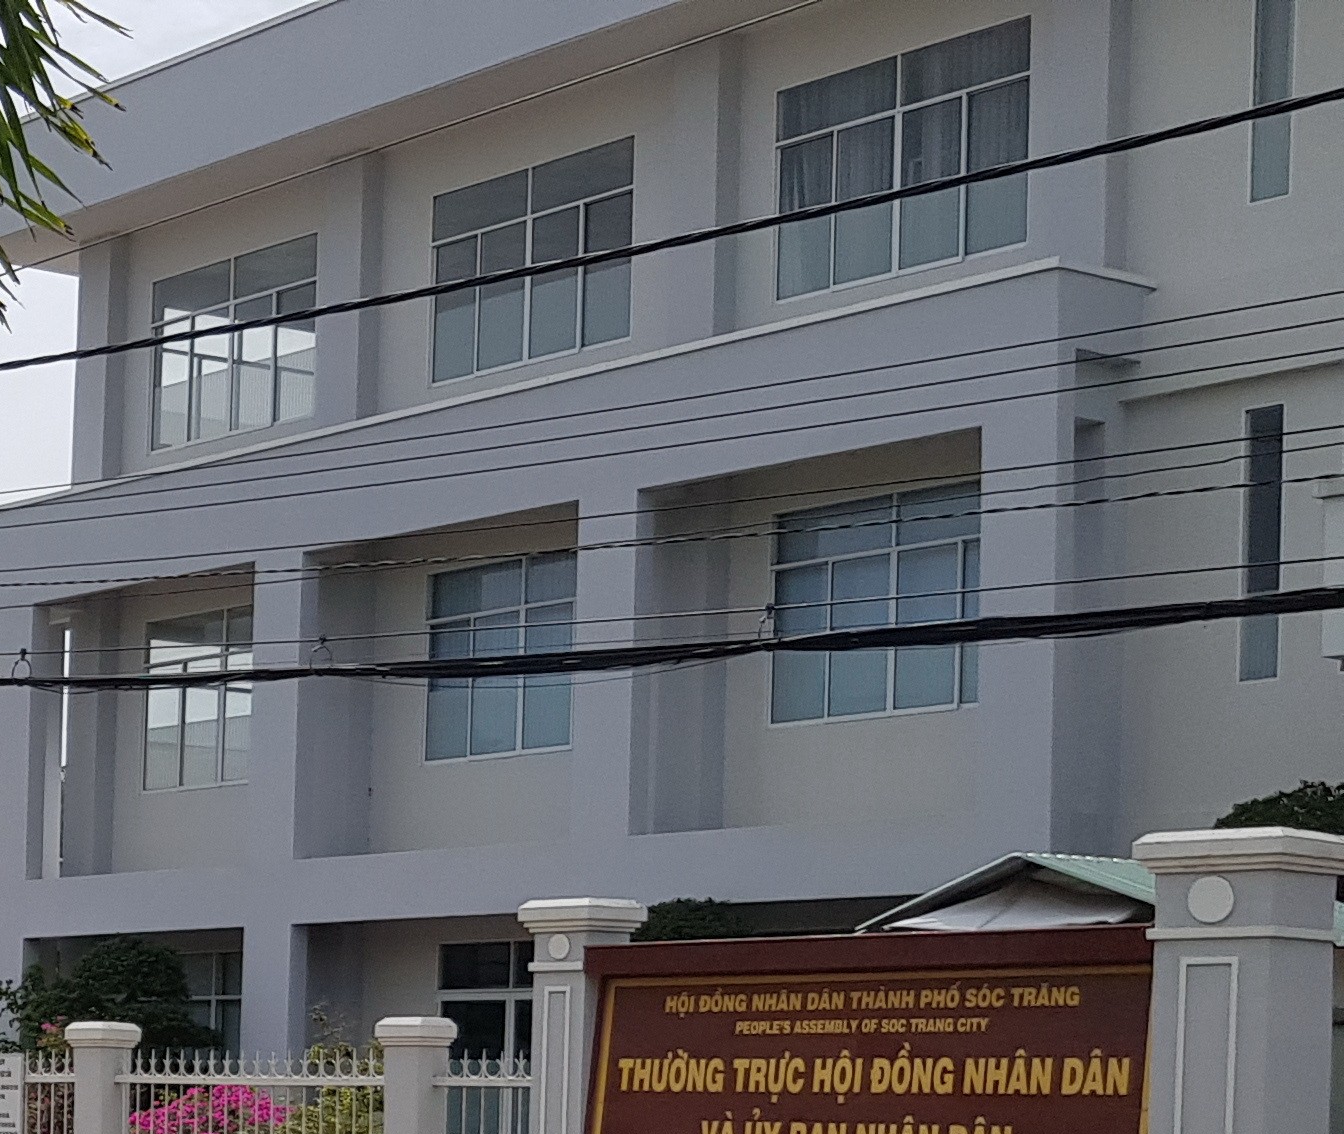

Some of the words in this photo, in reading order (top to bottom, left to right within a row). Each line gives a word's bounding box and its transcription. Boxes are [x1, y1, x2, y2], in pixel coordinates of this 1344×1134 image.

[665, 992, 695, 1018] HỘI
[698, 987, 748, 1013] ĐỒNG
[752, 989, 803, 1012] NHÂN
[806, 988, 846, 1011] DÂN
[850, 986, 915, 1009] THÀNH
[920, 981, 961, 1009] PHỐ
[965, 983, 1006, 1008] SÓC
[1011, 982, 1081, 1007] TRĂNG
[734, 1020, 791, 1036] PEOPLE'S
[793, 1019, 860, 1035] ASSEMBLY
[862, 1019, 879, 1033] OF
[880, 1018, 907, 1033] SOC
[910, 1018, 954, 1033] TRANG
[957, 1017, 991, 1032] CITY
[618, 1048, 725, 1094] THƯỜNG
[733, 1051, 806, 1104] TRỰC
[812, 1048, 864, 1104] HỘI
[870, 1042, 955, 1095] ĐỒNG
[963, 1048, 1054, 1096] NHÂN
[1061, 1048, 1131, 1096] DÂN
